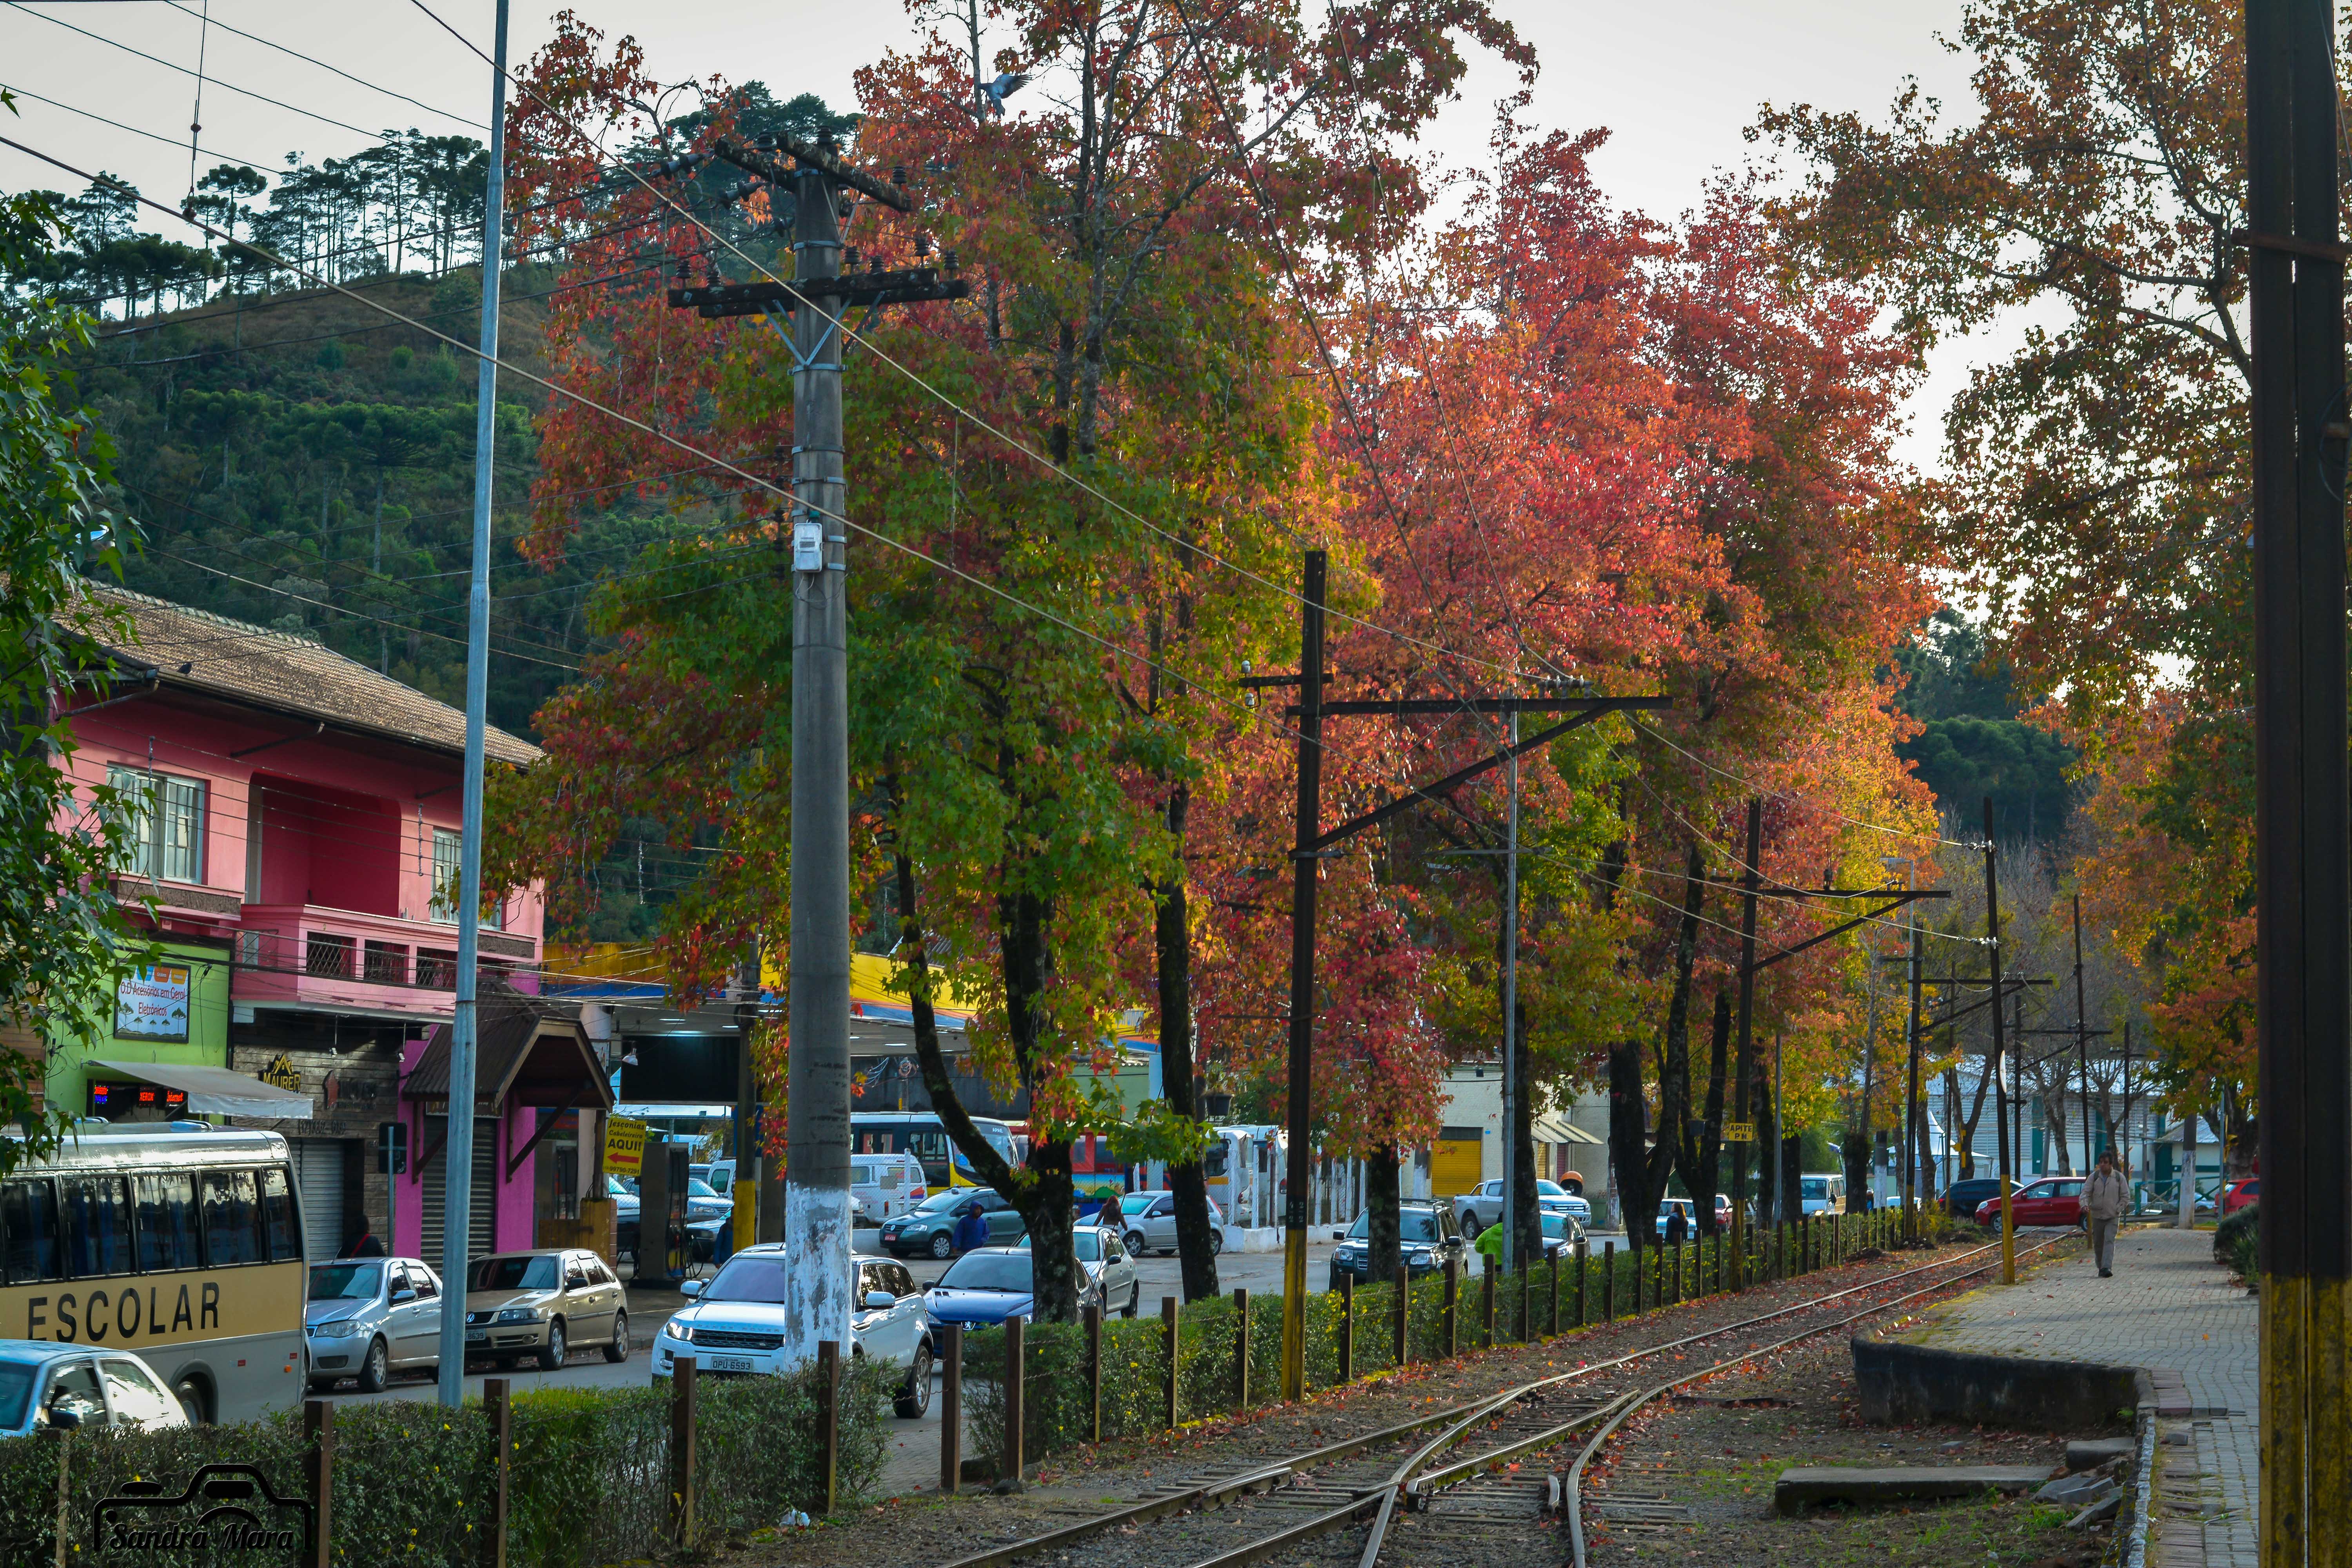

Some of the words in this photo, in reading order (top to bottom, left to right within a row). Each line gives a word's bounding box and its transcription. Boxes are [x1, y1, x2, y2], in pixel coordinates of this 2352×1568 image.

[161, 989, 169, 998] em
[171, 986, 185, 1000] Geral
[138, 1002, 167, 1016] Eletrônicos
[263, 1073, 301, 1091] MAURER
[139, 1092, 154, 1101] XEROX
[607, 1138, 642, 1151] AQUI!
[28, 1282, 220, 1343] ESCOLAR
[712, 1361, 751, 1370] OPU-6593
